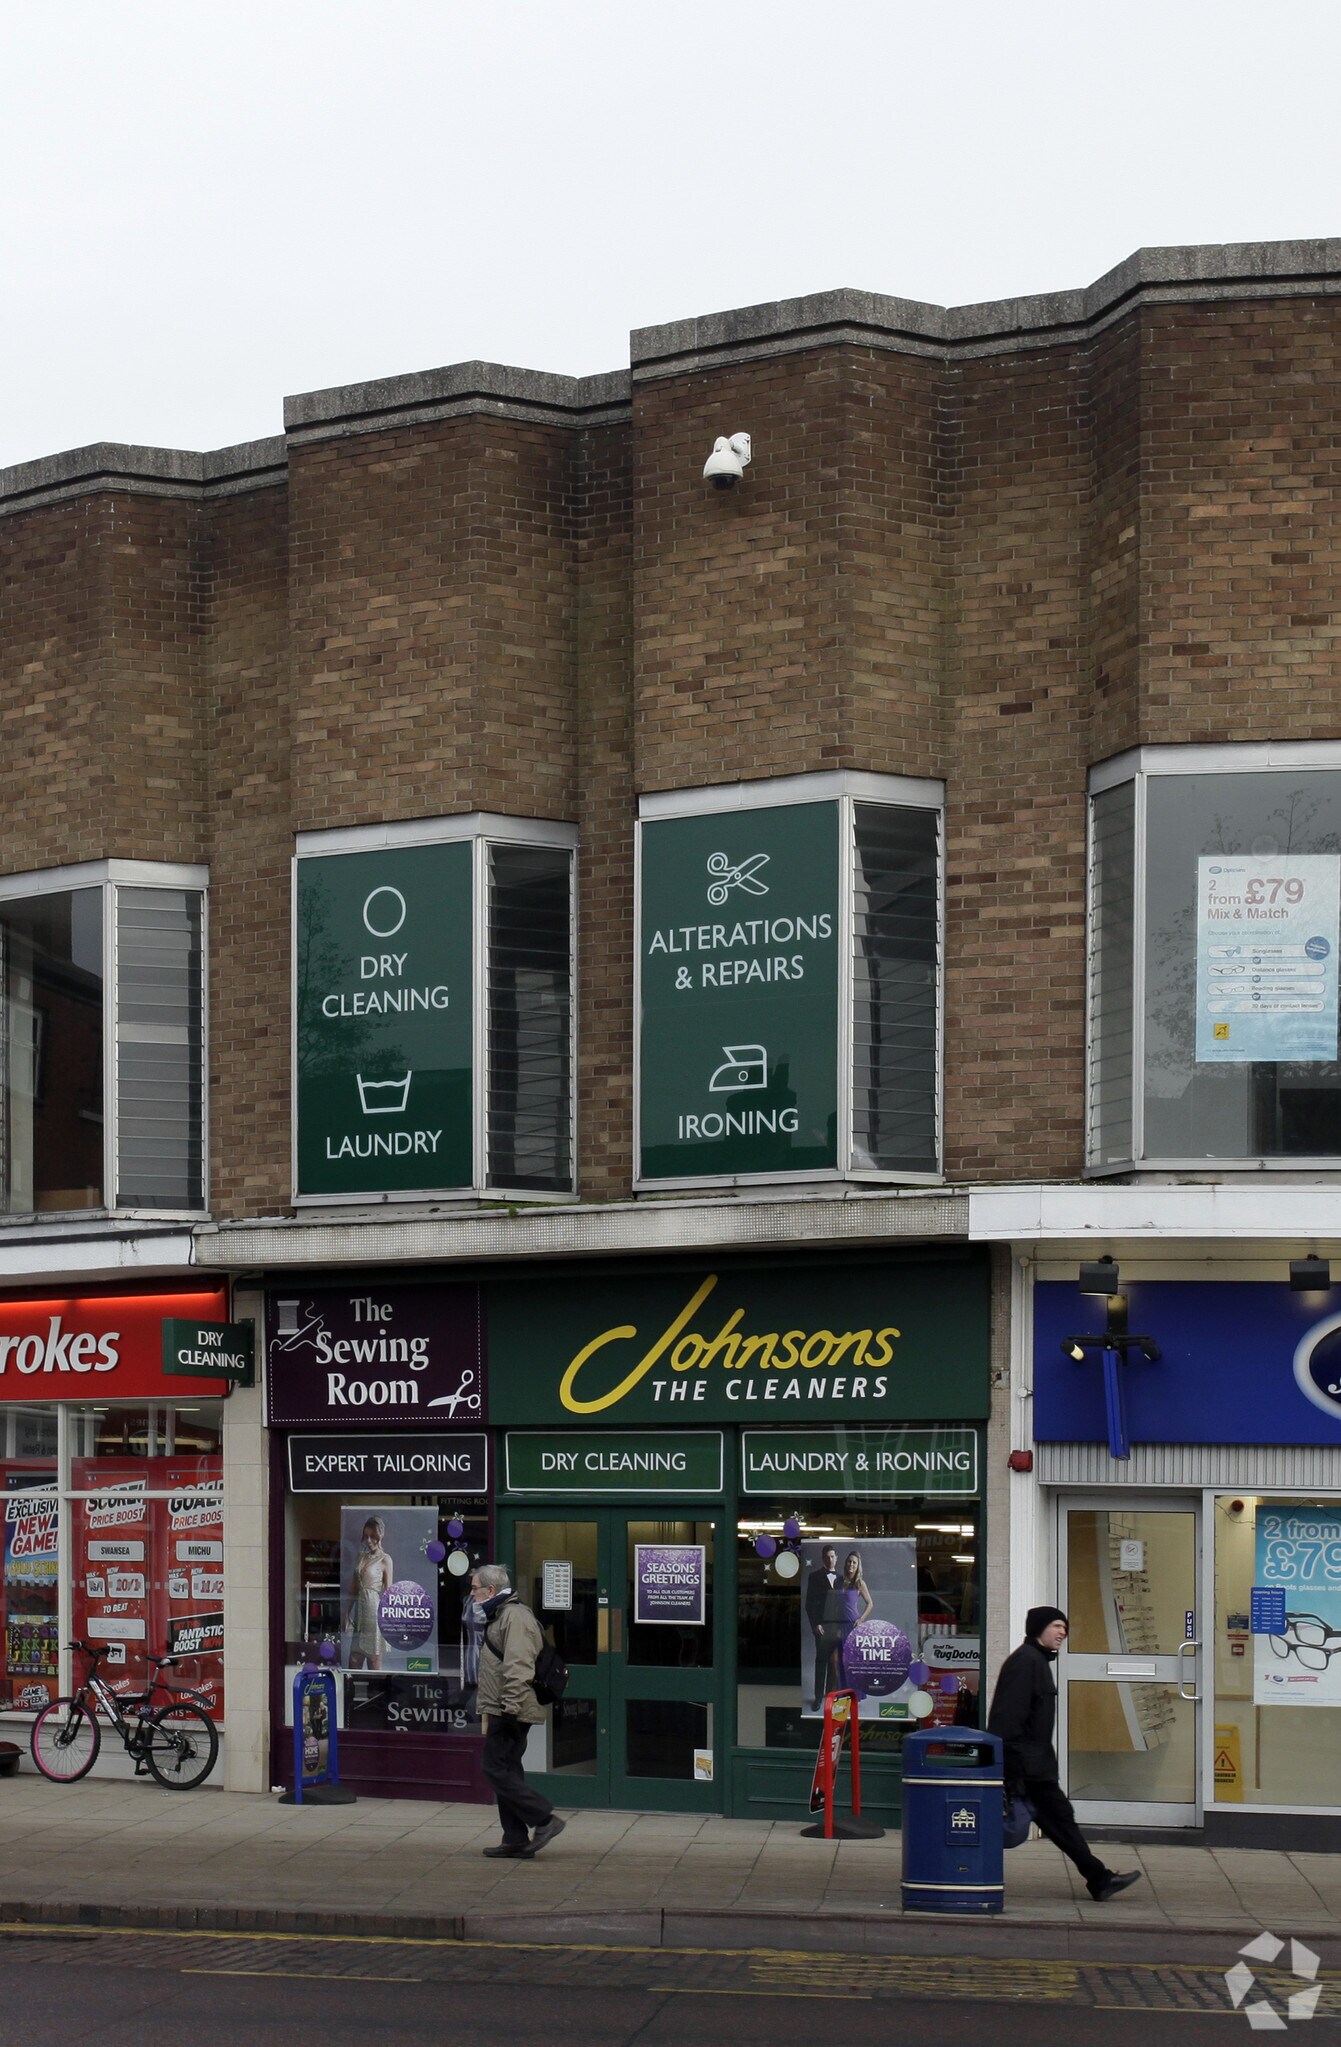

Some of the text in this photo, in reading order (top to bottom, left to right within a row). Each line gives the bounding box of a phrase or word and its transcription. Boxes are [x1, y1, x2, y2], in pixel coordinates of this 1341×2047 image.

[1208, 879, 1217, 891] 2
[1208, 893, 1241, 905] from
[1207, 907, 1289, 919] Mix & Match
[649, 913, 832, 955] ALTERATIONS
[360, 952, 408, 980] DRY
[675, 955, 804, 990] & REPAIRS
[322, 985, 449, 1018] CLEANING
[678, 1107, 799, 1139] IRONING
[326, 1129, 443, 1160] LAUNDRY
[350, 1297, 393, 1322] The
[197, 1330, 224, 1347] DRY
[559, 1274, 901, 1414] Johnsons
[178, 1349, 245, 1369] CLEANING
[316, 1329, 430, 1371] Sewing
[327, 1373, 419, 1405] Room
[652, 1376, 889, 1401] THE CLEANERS
[305, 1454, 471, 1472] EXPERT TAILORING
[541, 1452, 687, 1472] DRY CLEANING
[750, 1451, 970, 1472] LAUNDRY & IRONING
[7, 1500, 58, 1519] EXCLUSIV
[92, 1508, 143, 1527] PRICE BOOST
[17, 1514, 51, 1536] NEW
[174, 1515, 198, 1527] PRICE
[1264, 1516, 1341, 1540] 2 from
[13, 1531, 58, 1555] GAME!
[100, 1546, 130, 1555] SWANSEA
[188, 1546, 211, 1556] MICHU
[647, 1563, 695, 1573] SEASONS
[642, 1574, 700, 1584] GREETINGS
[103, 1602, 128, 1613] TO BEAT
[389, 1594, 425, 1606] PARTY
[381, 1607, 431, 1619] PRINCESS
[178, 1625, 224, 1641] FANTASTIC
[855, 1635, 899, 1648] PARTY
[173, 1638, 201, 1652] BOOST
[860, 1649, 891, 1661] TIME
[412, 1684, 443, 1699] The
[387, 1702, 468, 1729] Sewing
